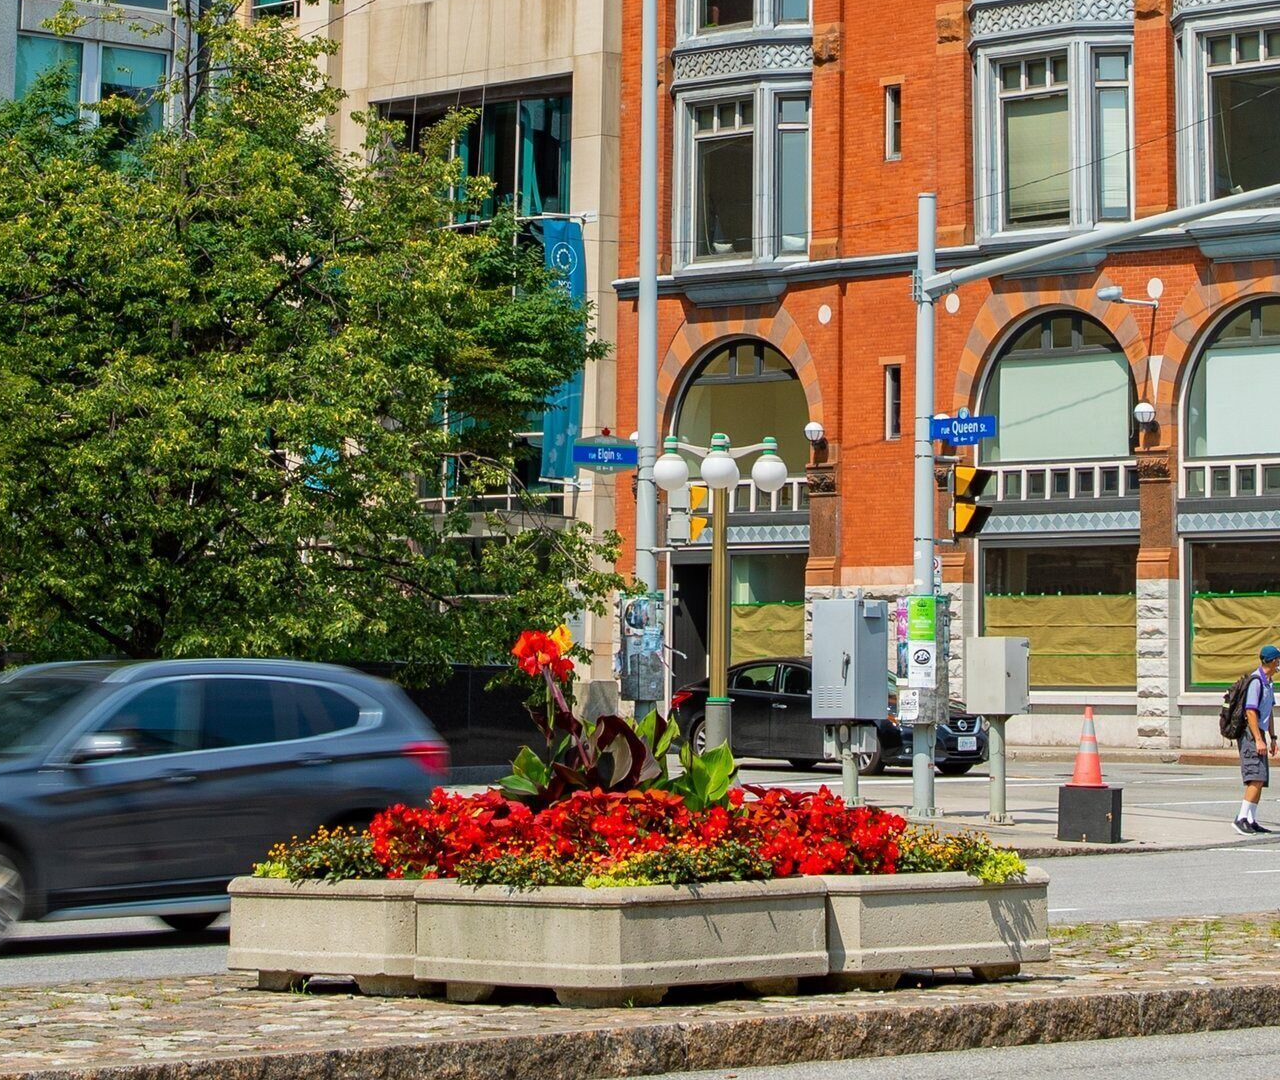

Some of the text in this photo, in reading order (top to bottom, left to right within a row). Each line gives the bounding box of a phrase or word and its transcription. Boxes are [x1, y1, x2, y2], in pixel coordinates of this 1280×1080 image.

[940, 427, 951, 435] rue
[952, 421, 979, 436] Queen
[597, 448, 615, 463] Elgin
